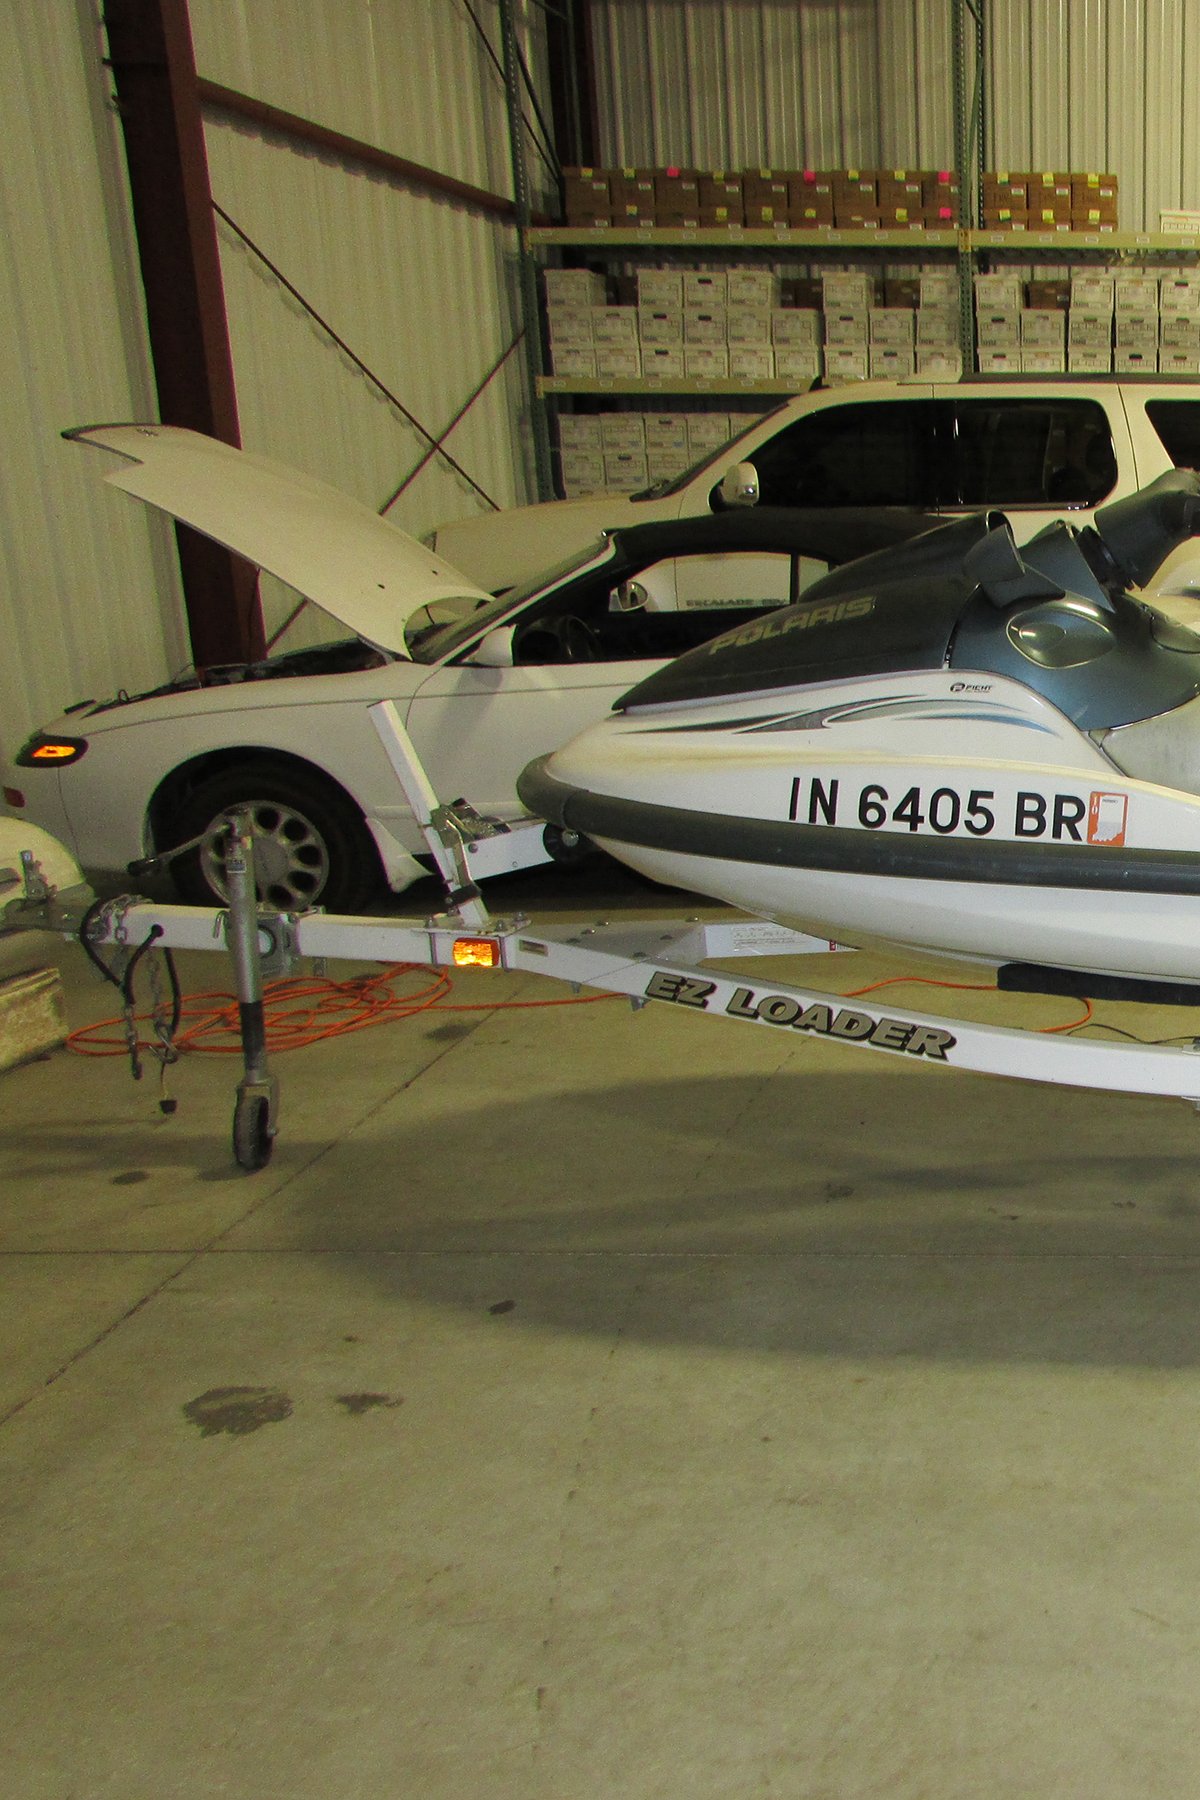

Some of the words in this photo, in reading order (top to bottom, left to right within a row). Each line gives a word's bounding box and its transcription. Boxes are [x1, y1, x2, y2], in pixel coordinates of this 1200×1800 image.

[708, 596, 876, 655] POLARIS
[789, 777, 839, 826] IN
[858, 785, 995, 836] 6405
[1015, 791, 1086, 842] BR
[645, 971, 717, 1010] EZ
[726, 987, 957, 1061] LOADER
